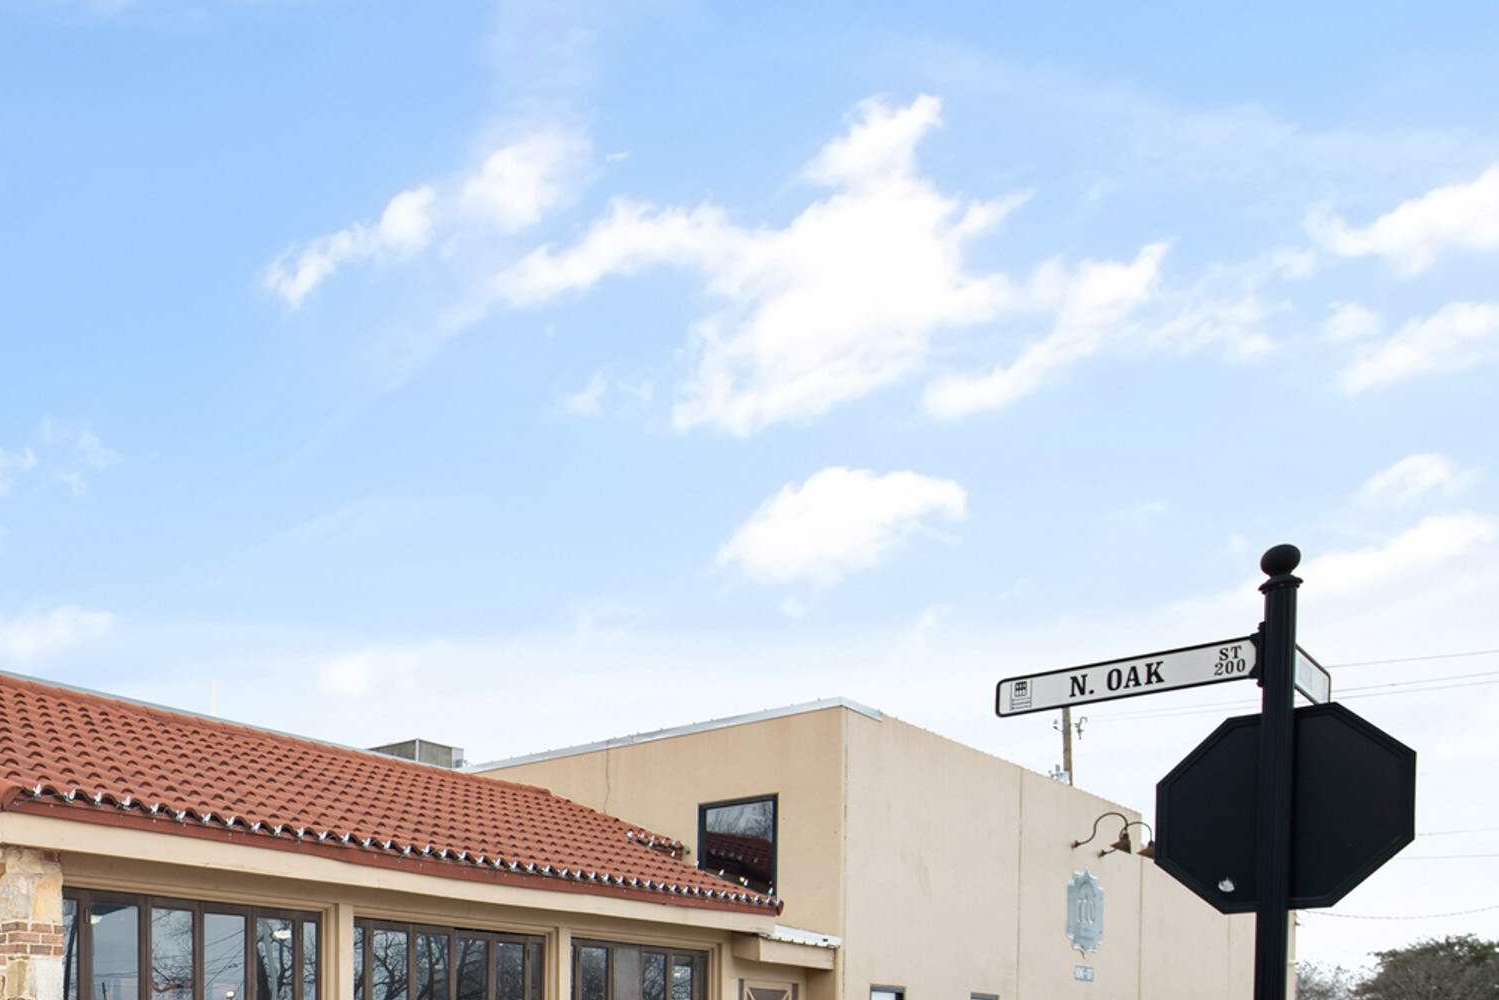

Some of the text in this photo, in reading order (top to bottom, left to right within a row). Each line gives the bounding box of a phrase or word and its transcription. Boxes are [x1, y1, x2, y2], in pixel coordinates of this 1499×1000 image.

[1219, 645, 1243, 661] ST
[1214, 658, 1246, 677] 200
[1069, 661, 1165, 698] N. OAK
